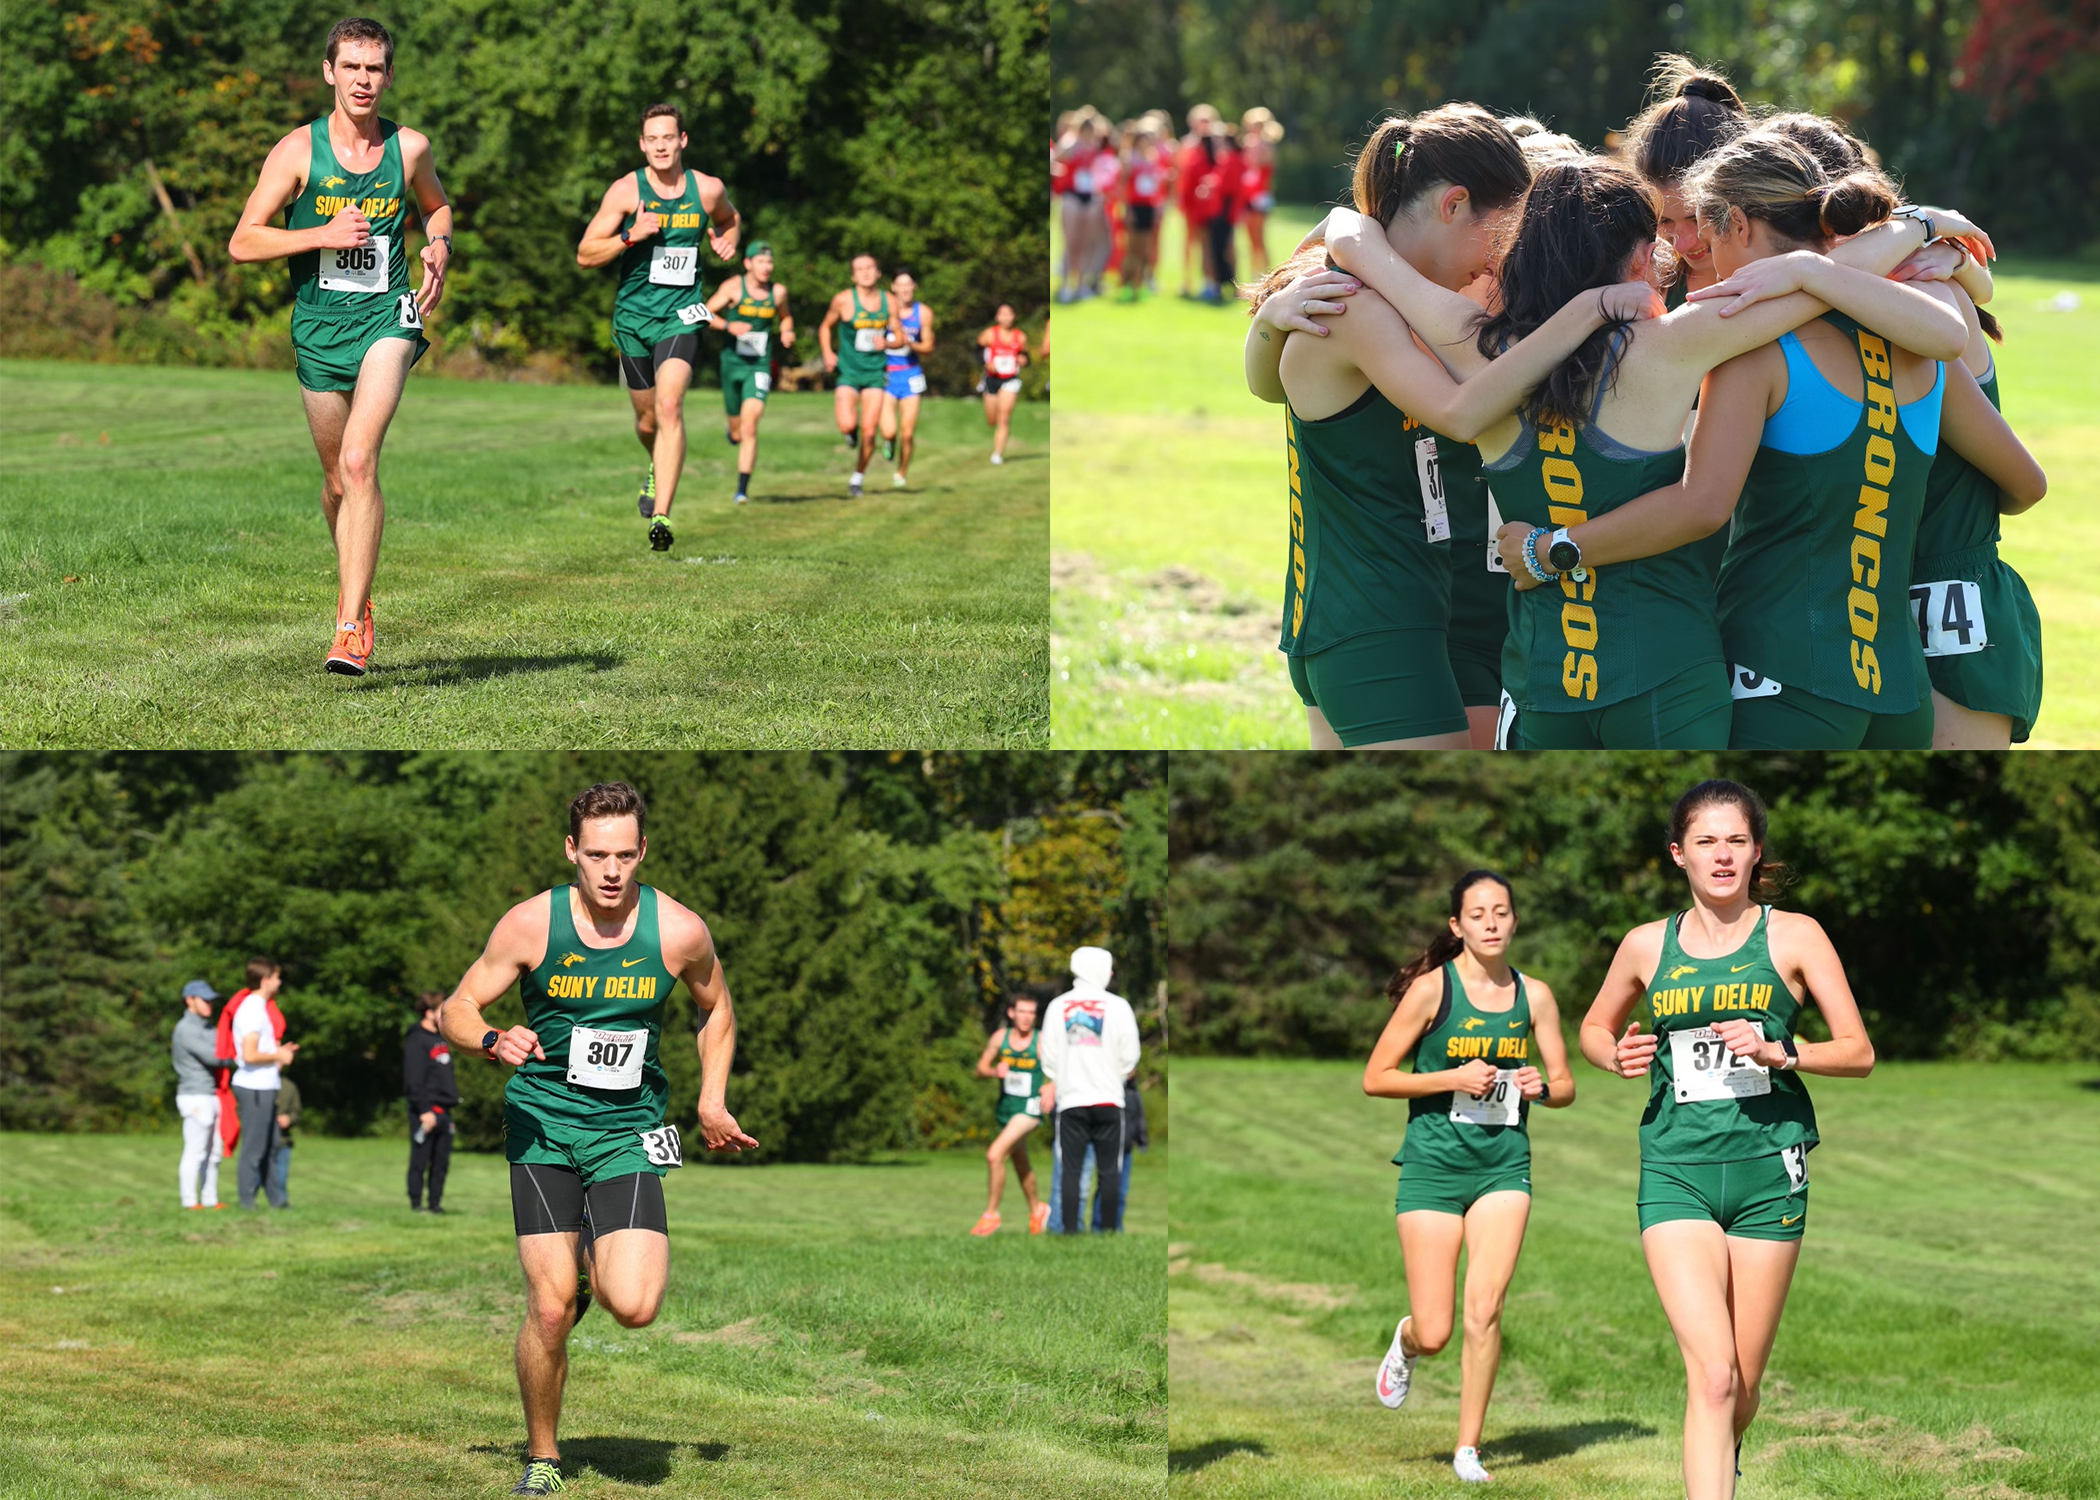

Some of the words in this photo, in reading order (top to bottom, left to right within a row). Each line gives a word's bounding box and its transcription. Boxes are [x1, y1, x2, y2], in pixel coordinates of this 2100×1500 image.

[672, 213, 700, 228] DELHI
[336, 247, 376, 271] 305
[663, 255, 688, 271] 307
[1847, 328, 1899, 696] BRONCOS
[547, 974, 598, 998] SUNY
[604, 976, 656, 999] DELHI
[1652, 985, 1706, 1018] SUNY
[1714, 983, 1773, 1010] DELHI
[587, 1041, 634, 1067] 307
[1446, 1036, 1493, 1058] SUNY
[1496, 1037, 1528, 1059] DELH
[649, 1128, 680, 1162] 30
